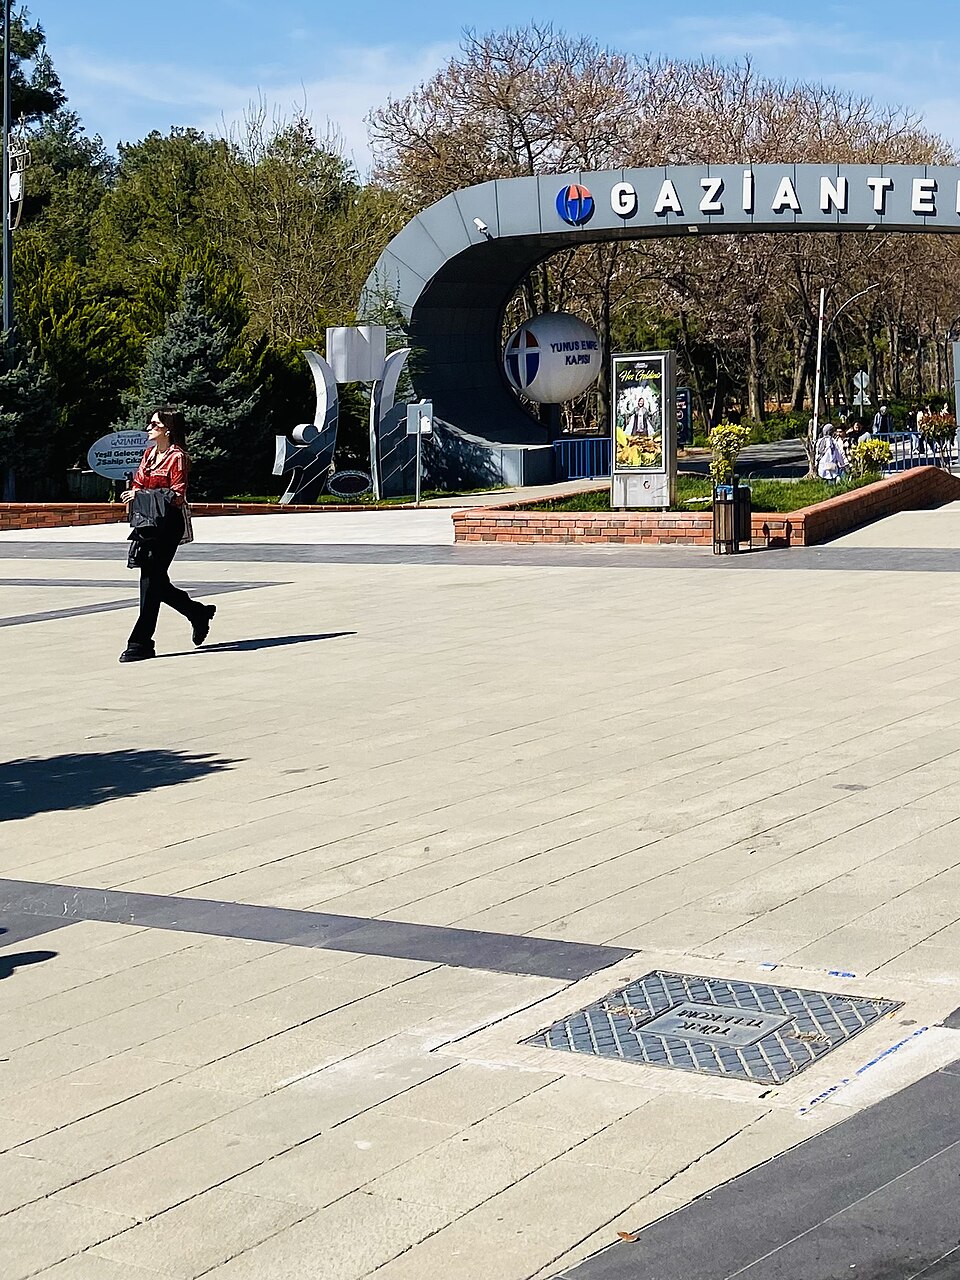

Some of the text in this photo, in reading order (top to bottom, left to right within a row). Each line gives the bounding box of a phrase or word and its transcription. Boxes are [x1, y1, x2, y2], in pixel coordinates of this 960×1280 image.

[550, 340, 598, 353] YUNUS EMRE
[565, 354, 590, 366] KAPISI
